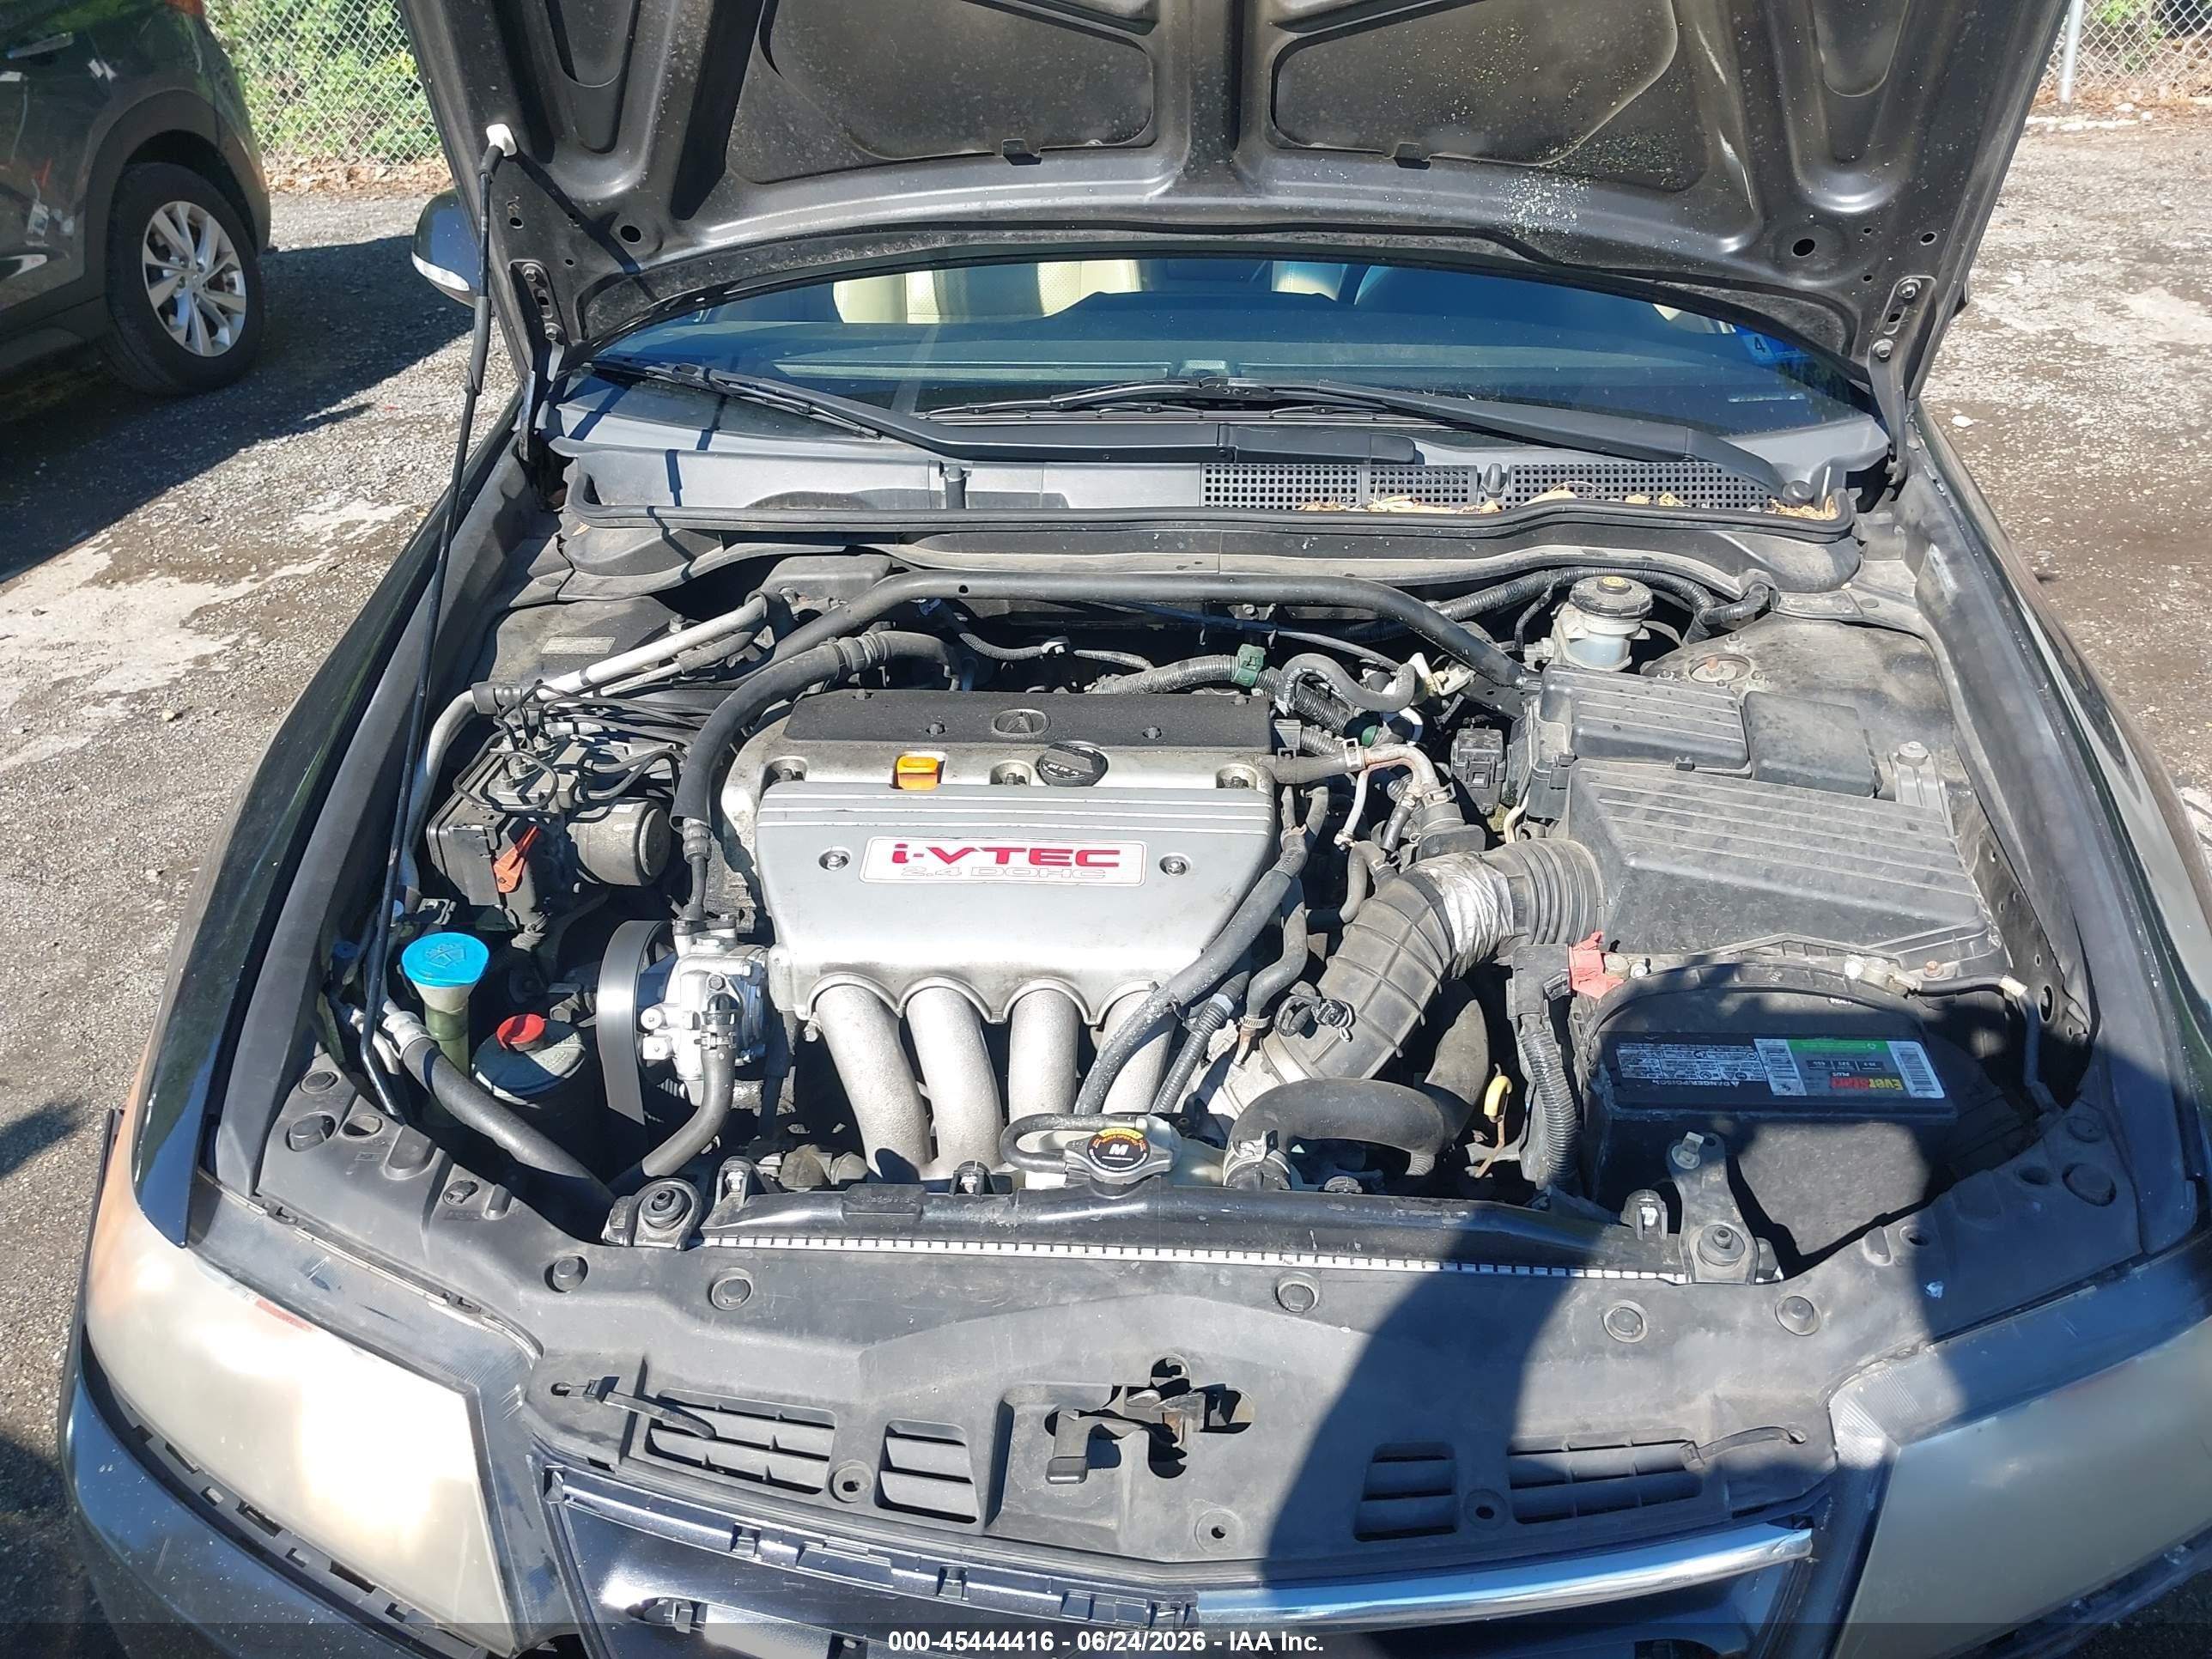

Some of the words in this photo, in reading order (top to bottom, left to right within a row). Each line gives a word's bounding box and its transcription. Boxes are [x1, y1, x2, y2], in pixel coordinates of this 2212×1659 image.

[1754, 337, 1765, 353] 4
[891, 843, 1121, 867] i-VTEC
[901, 866, 963, 878] 2.4
[970, 866, 1106, 878] DOHC
[1829, 1076, 1904, 1091] EverStart
